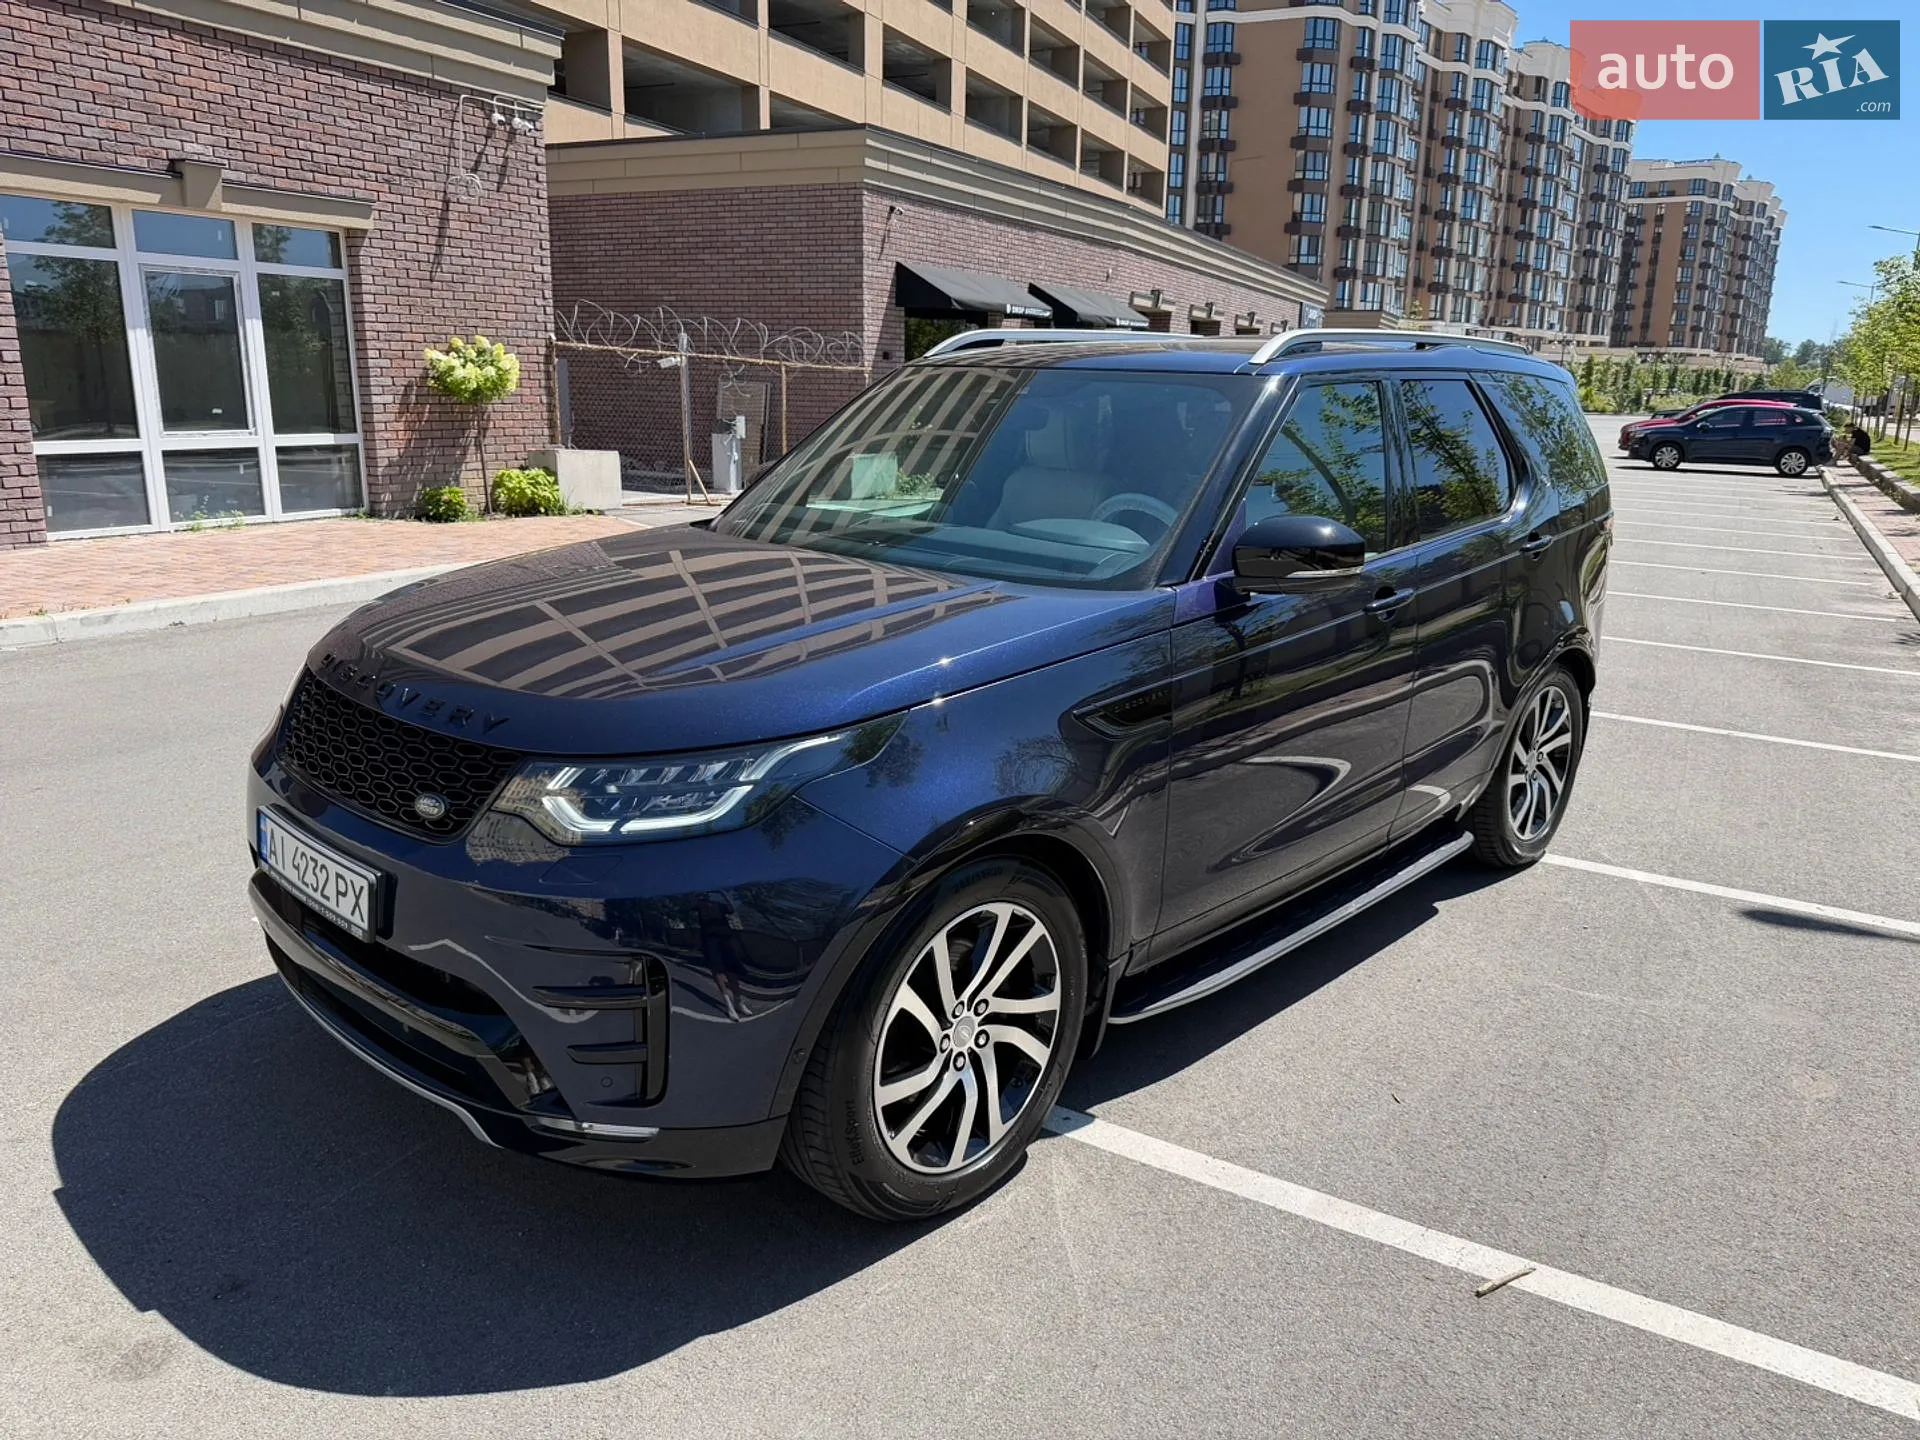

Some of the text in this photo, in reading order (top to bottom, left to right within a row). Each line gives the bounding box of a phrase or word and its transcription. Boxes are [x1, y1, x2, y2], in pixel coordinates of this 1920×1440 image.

[269, 827, 286, 872] AI
[291, 846, 331, 903] 4232
[335, 870, 366, 924] PX
